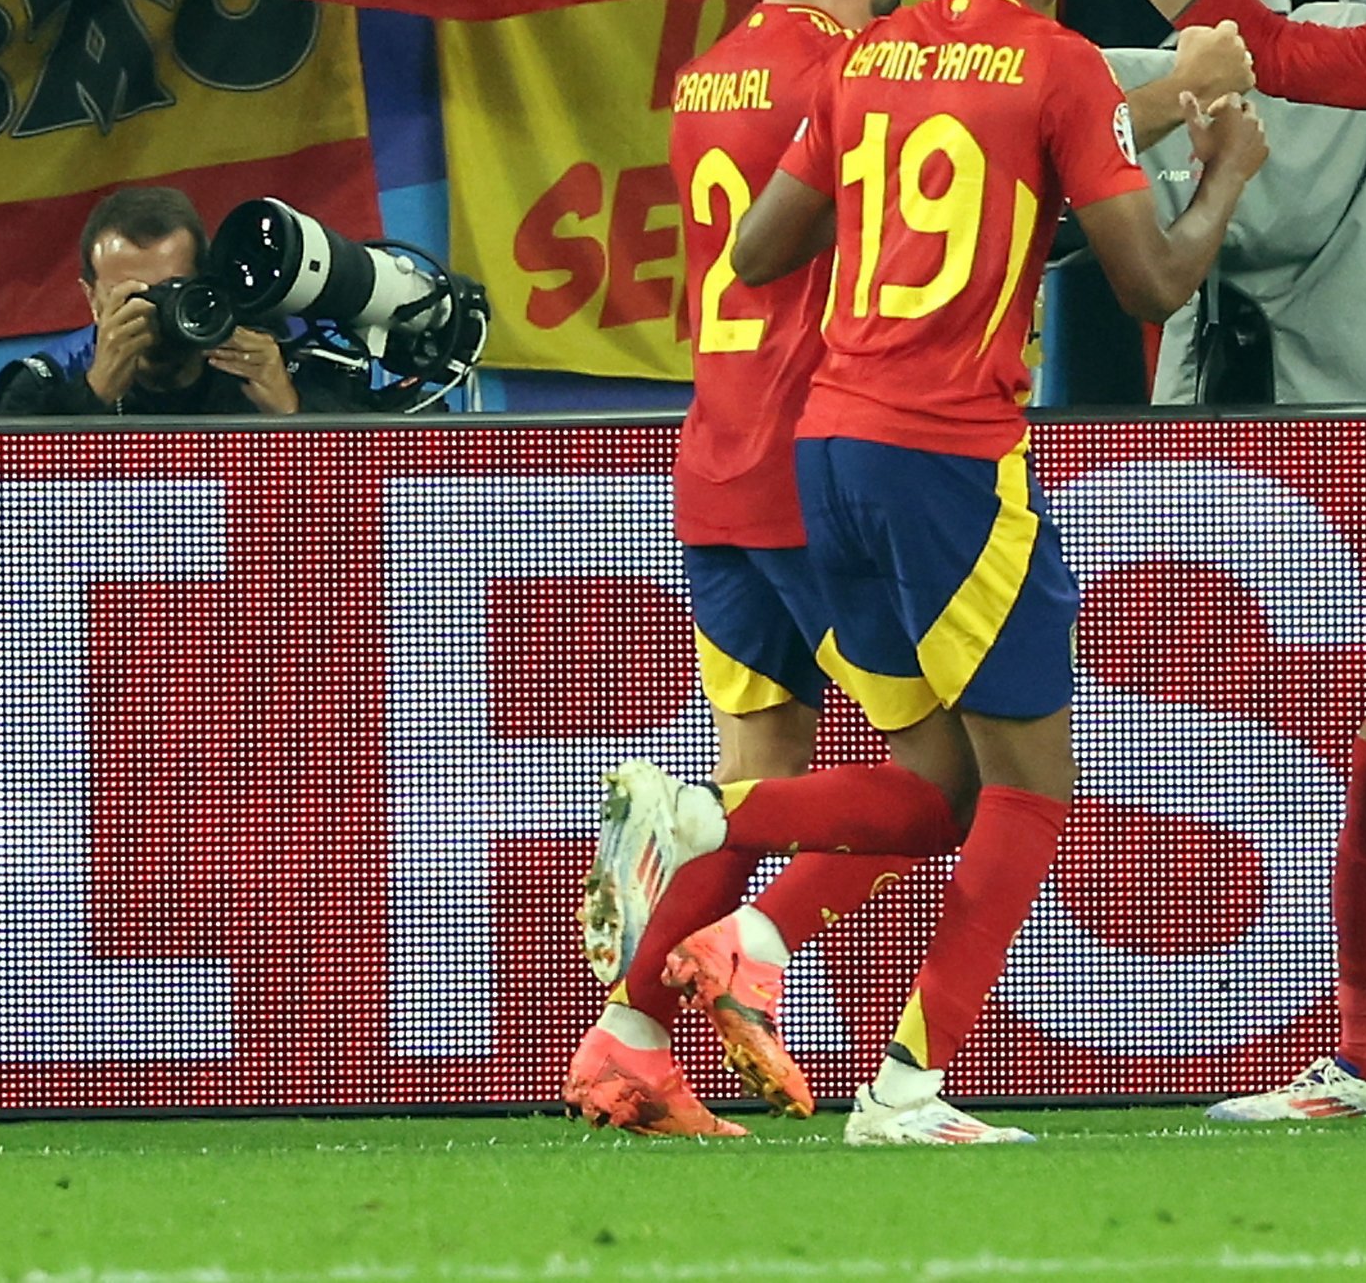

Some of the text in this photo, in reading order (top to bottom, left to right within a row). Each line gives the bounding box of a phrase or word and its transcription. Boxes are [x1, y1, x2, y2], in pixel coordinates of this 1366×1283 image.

[674, 69, 773, 113] CARVAJAL
[843, 41, 1026, 85] LAMINE YAMAL
[691, 147, 766, 354] 2
[842, 112, 987, 319] 19
